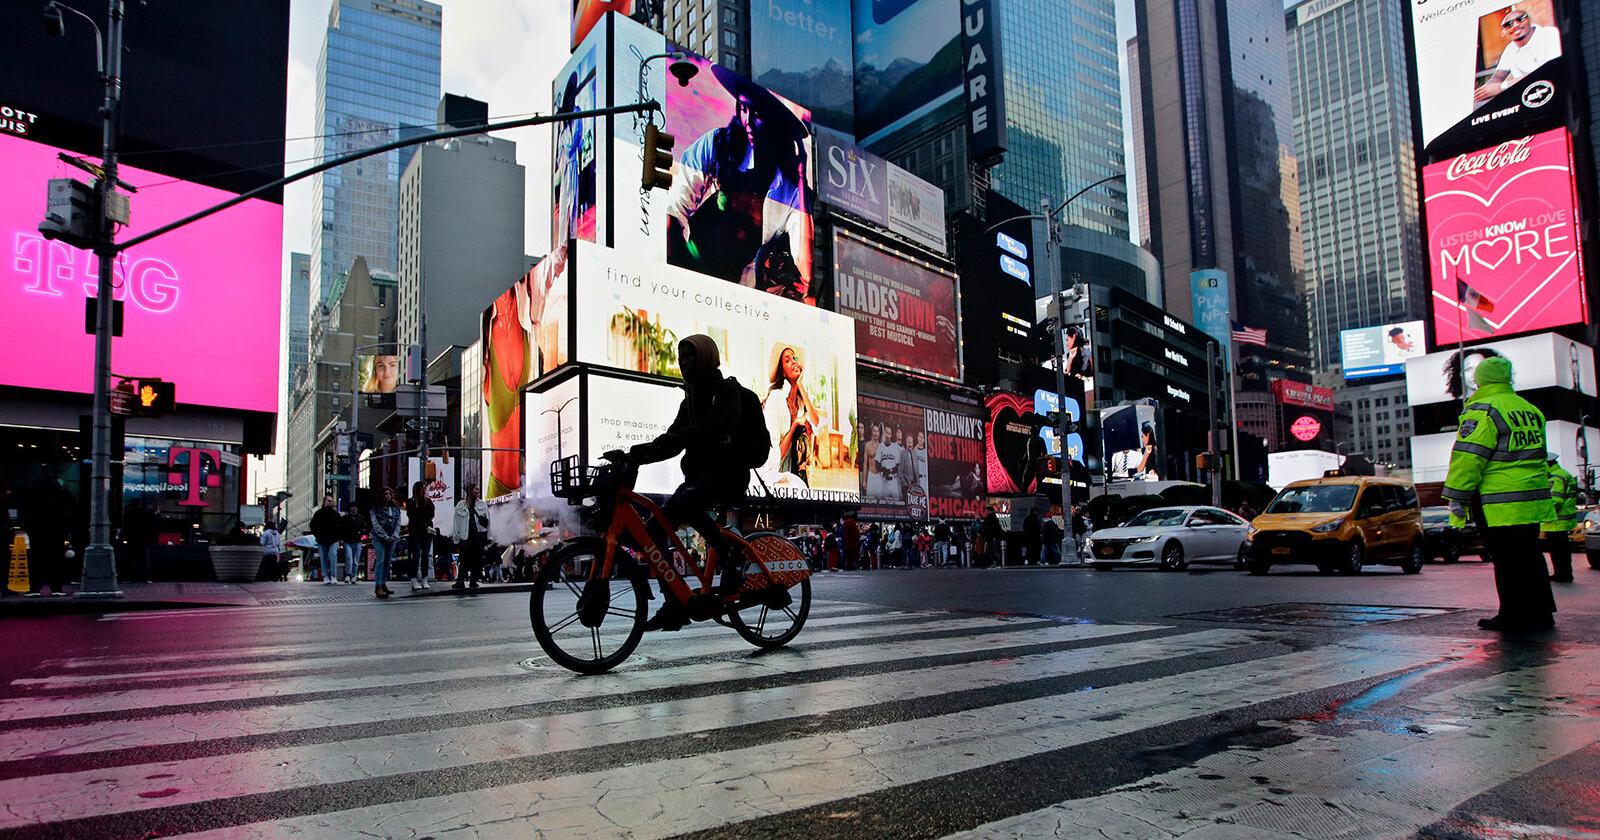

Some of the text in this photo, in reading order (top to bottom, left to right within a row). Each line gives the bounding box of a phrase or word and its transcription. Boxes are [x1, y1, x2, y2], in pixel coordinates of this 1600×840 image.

[964, 0, 988, 134] UARE
[1471, 104, 1521, 126] LIVE EVENT
[1440, 209, 1566, 248] LISTEN KNOW LOVE
[606, 266, 771, 321] find your collective
[839, 272, 936, 333] HADESTOWN
[869, 323, 915, 346] BEST MUSICAL
[600, 417, 621, 427] shop
[623, 420, 659, 430] madison
[616, 431, 622, 439] &
[926, 408, 983, 440] BROADWAY'S
[927, 432, 953, 460] SURE
[166, 446, 221, 507] T
[800, 488, 860, 503] OUTFITTERS
[920, 496, 928, 507] ME
[911, 508, 922, 517] OUT
[644, 544, 676, 582] JOCO
[770, 561, 803, 570] JOCO
